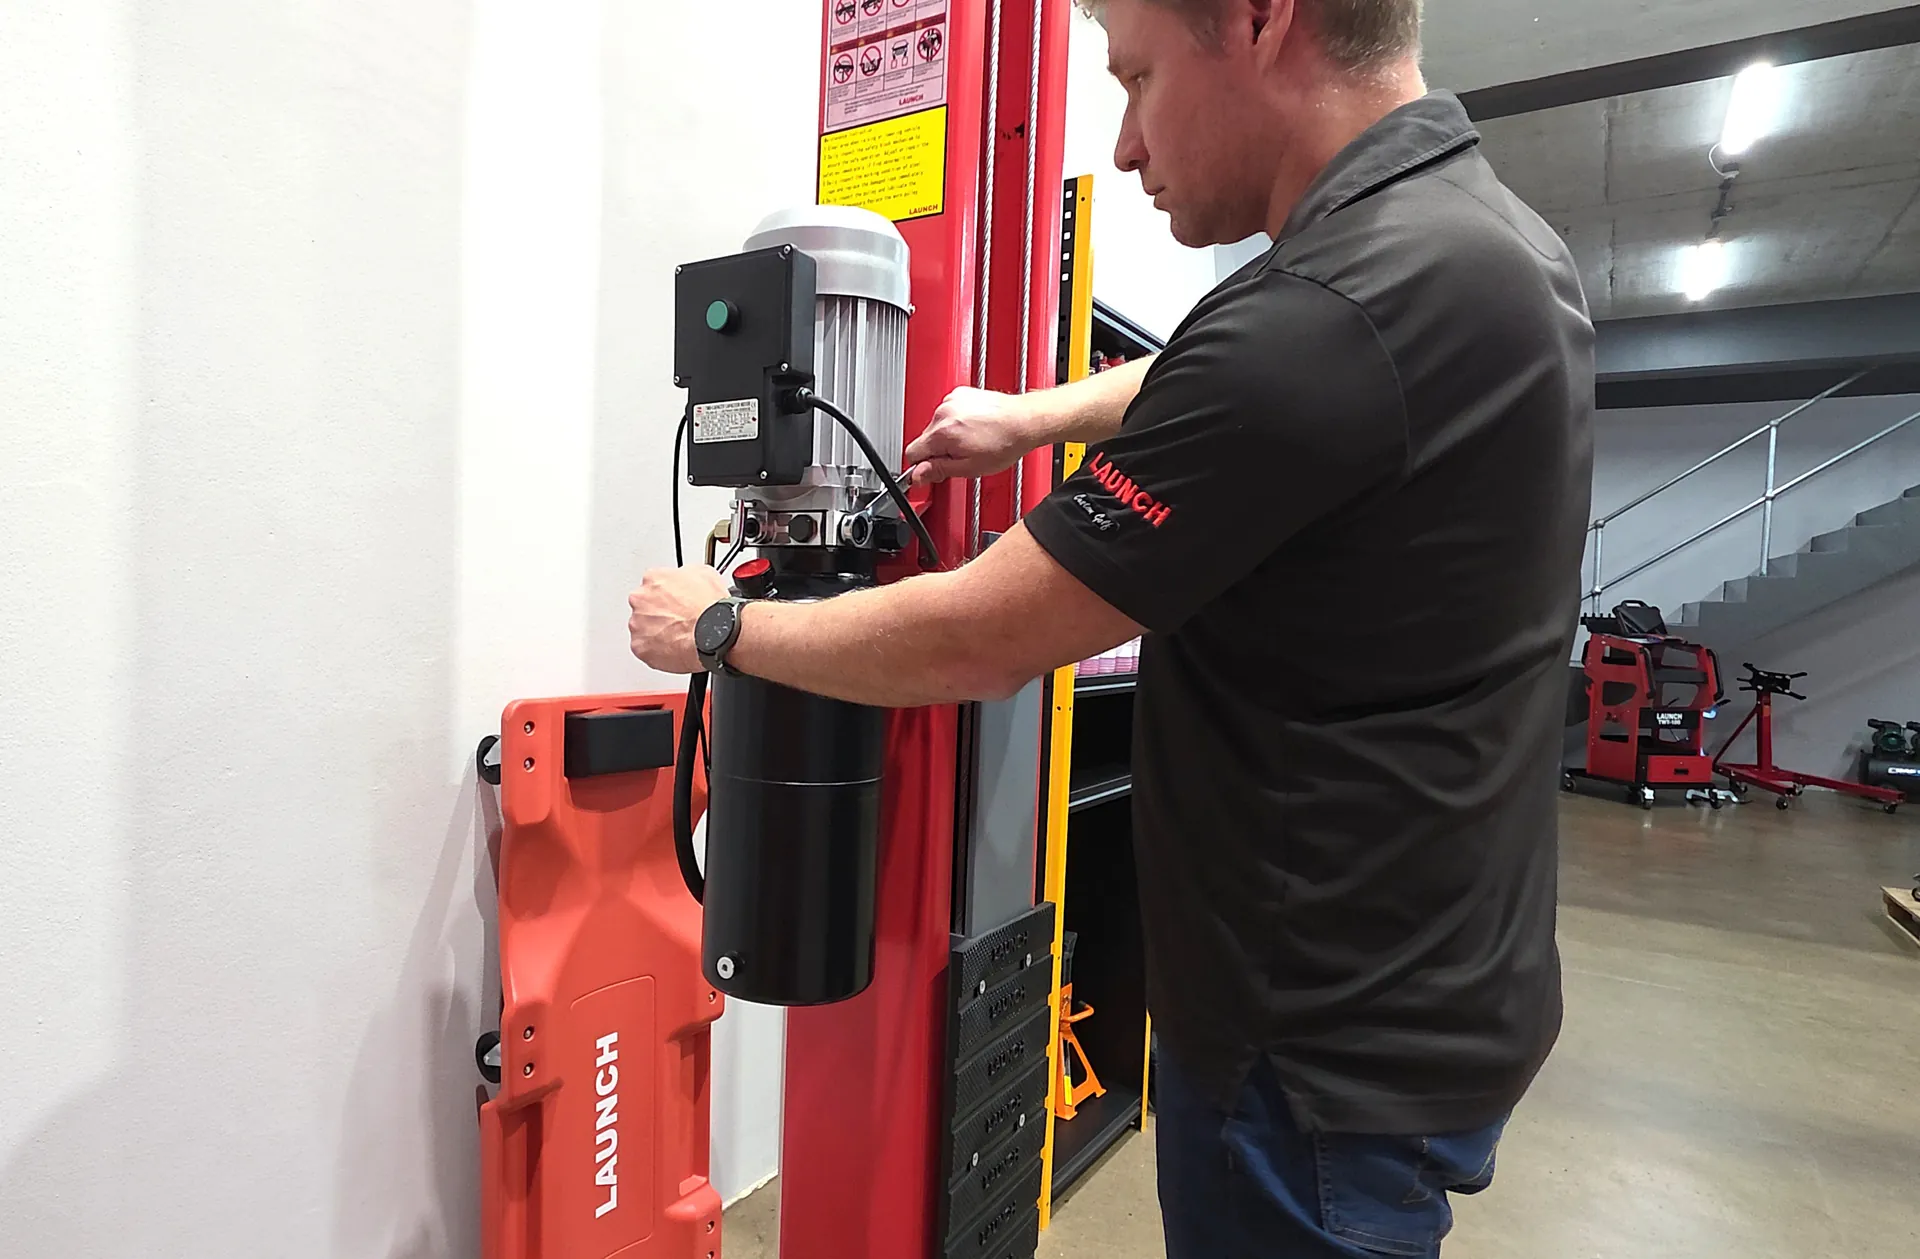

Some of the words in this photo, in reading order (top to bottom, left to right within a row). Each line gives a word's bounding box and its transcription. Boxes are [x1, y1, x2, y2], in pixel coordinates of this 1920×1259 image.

[899, 94, 924, 106] LAUNCH
[909, 204, 938, 215] LAUNCH
[1088, 451, 1172, 528] LAUNCH
[595, 1031, 619, 1219] LAUNCH
